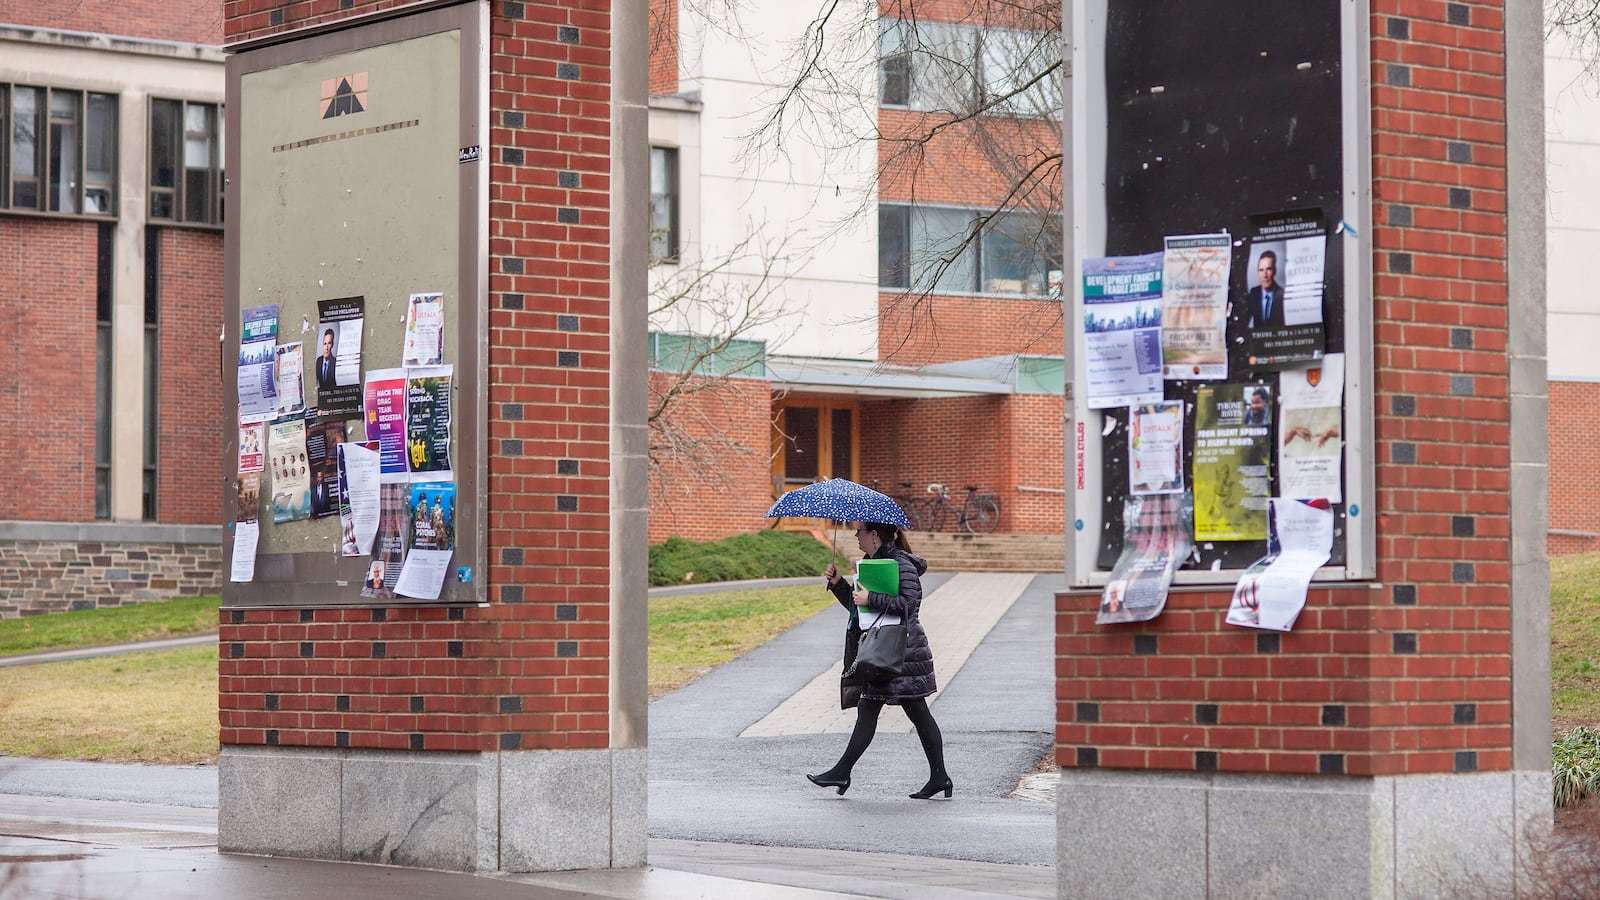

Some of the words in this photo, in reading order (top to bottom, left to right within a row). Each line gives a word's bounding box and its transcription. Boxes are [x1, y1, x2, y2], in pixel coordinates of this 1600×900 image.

[375, 119, 420, 134] CENTER
[1260, 226, 1285, 235] THOMAS
[1087, 273, 1132, 287] DEVELOPMENT
[1132, 271, 1154, 283] FINANCE
[1103, 282, 1129, 296] FRAGILE
[1129, 280, 1149, 293] STATES
[1170, 332, 1194, 341] FRIDAY
[376, 388, 391, 397] HACK
[392, 388, 403, 396] THE
[410, 387, 426, 395] SPRING
[377, 397, 391, 406] DRAG
[410, 395, 434, 403] KICKBACK
[378, 406, 392, 414] TEAM
[1217, 401, 1243, 411] TYRONE
[378, 413, 402, 422] REGISTRA
[379, 423, 391, 431] TION
[1198, 429, 1216, 438] FROM
[1217, 428, 1239, 437] SILENT
[1240, 427, 1268, 436] SPRING
[1198, 439, 1206, 447] TO
[1207, 438, 1228, 447] SILENT
[1229, 437, 1254, 446] NIGHT:
[415, 521, 431, 529] CORAL
